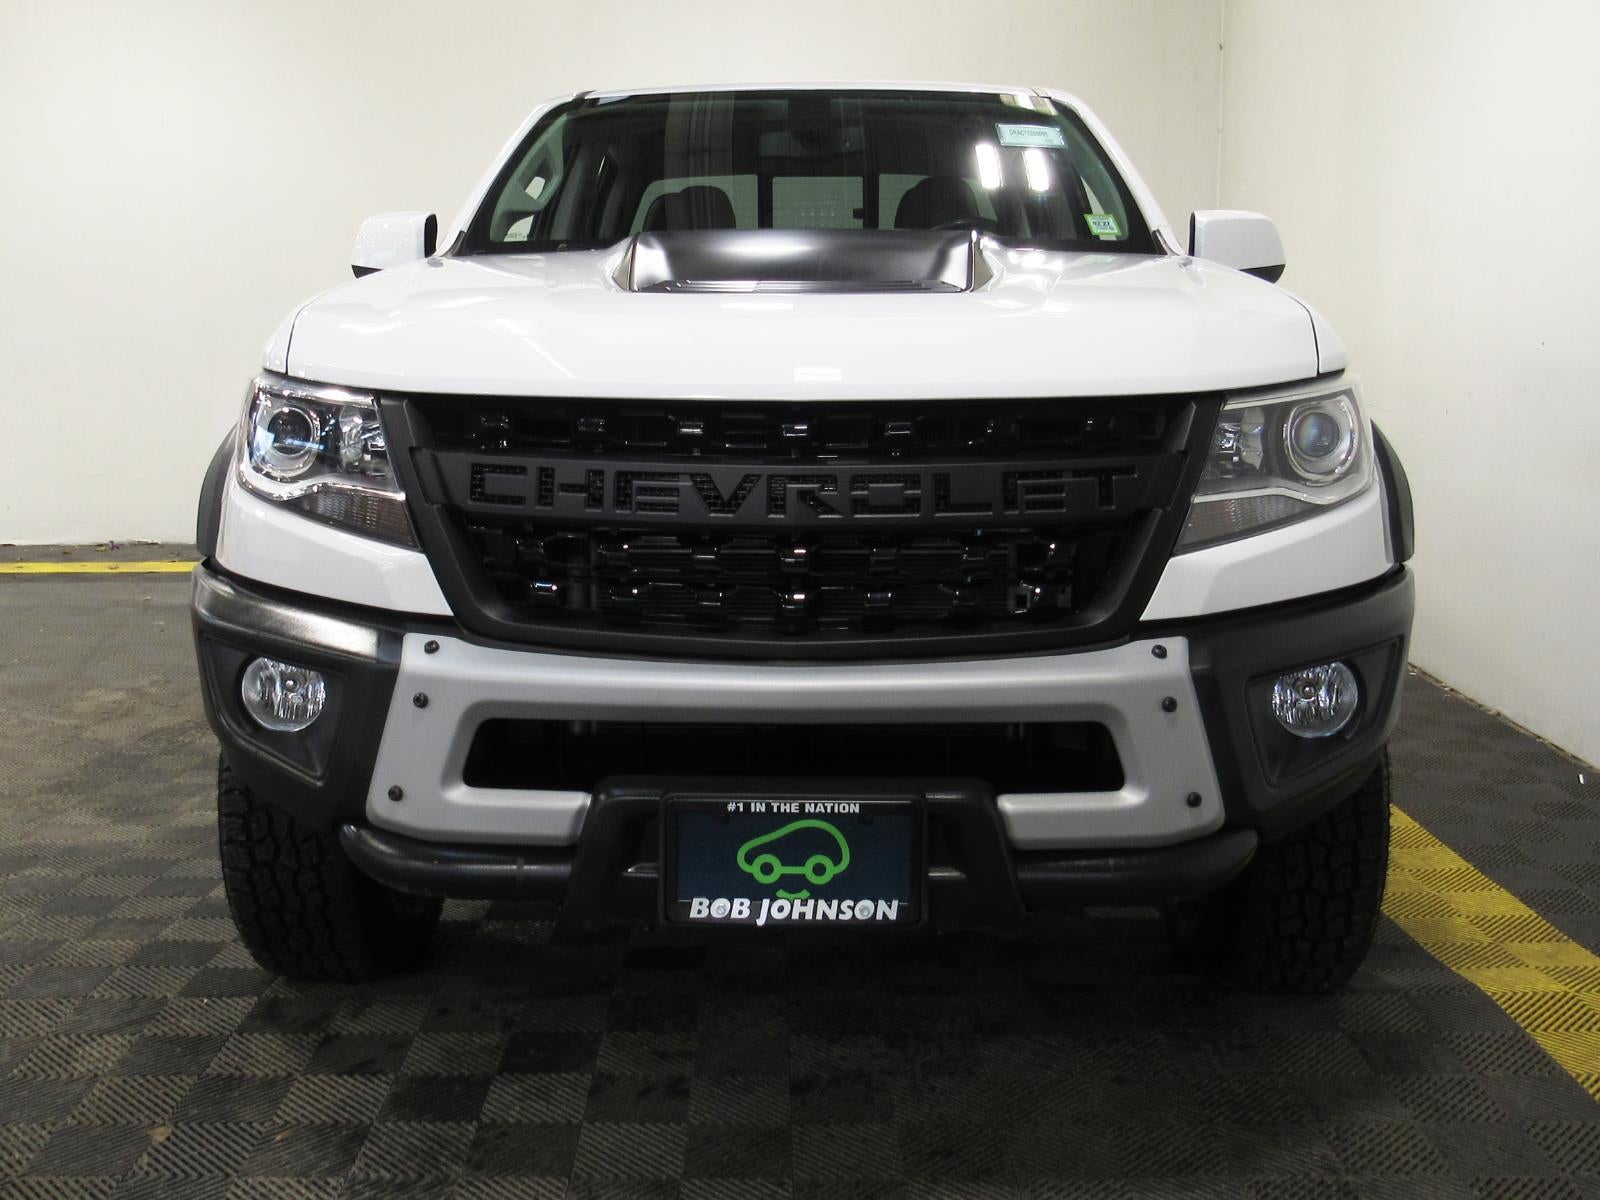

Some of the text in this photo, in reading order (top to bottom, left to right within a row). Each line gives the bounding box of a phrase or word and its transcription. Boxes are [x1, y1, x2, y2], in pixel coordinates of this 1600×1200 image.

[469, 461, 1139, 519] CHEVROLET
[726, 802, 860, 814] #1 IN THE NATION
[689, 897, 899, 926] BOB JOHNSON
